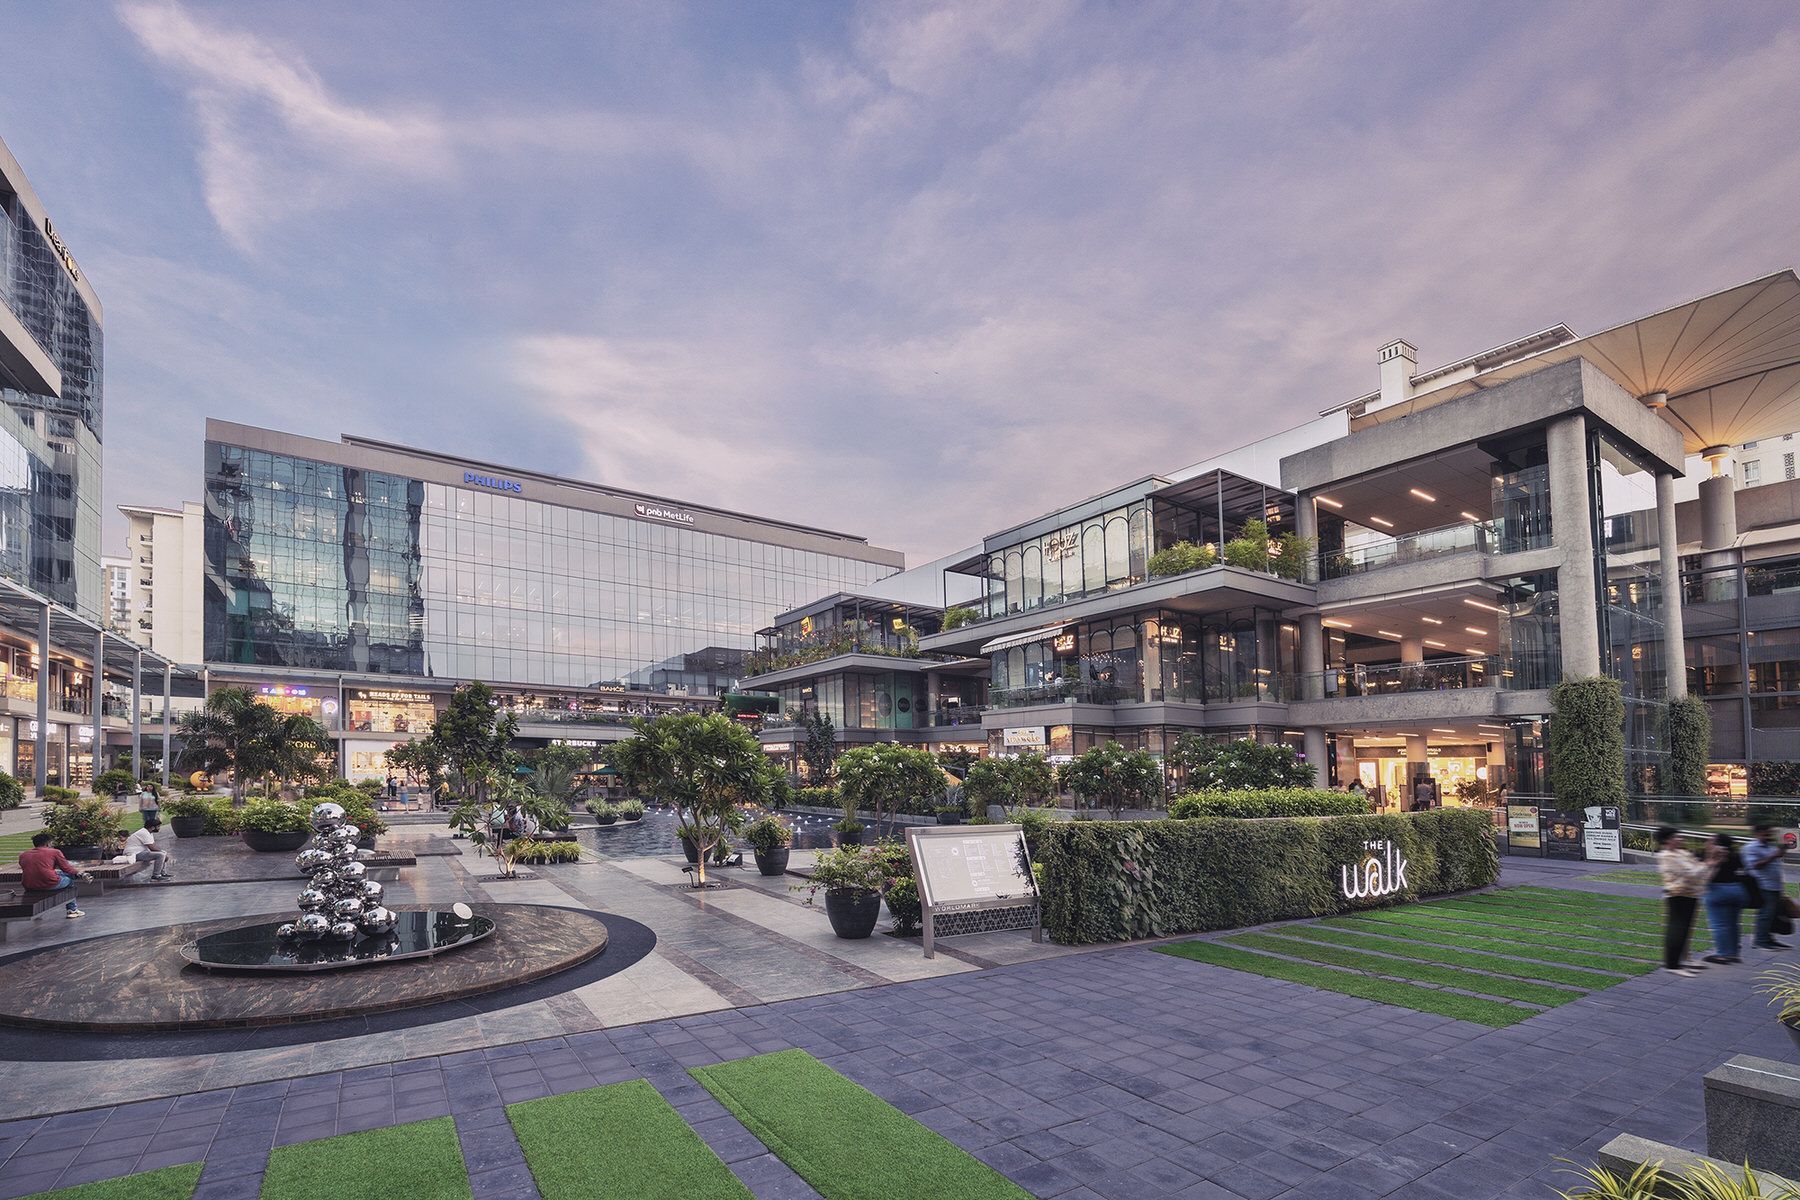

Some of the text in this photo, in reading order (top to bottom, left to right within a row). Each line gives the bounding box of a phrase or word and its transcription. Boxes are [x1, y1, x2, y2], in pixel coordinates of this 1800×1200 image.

[464, 471, 522, 493] PHILIPS
[646, 508, 694, 523] pnb MetLife
[1363, 841, 1383, 850] THE
[1342, 840, 1408, 899] walk
[934, 903, 980, 912] WORLDMARK
